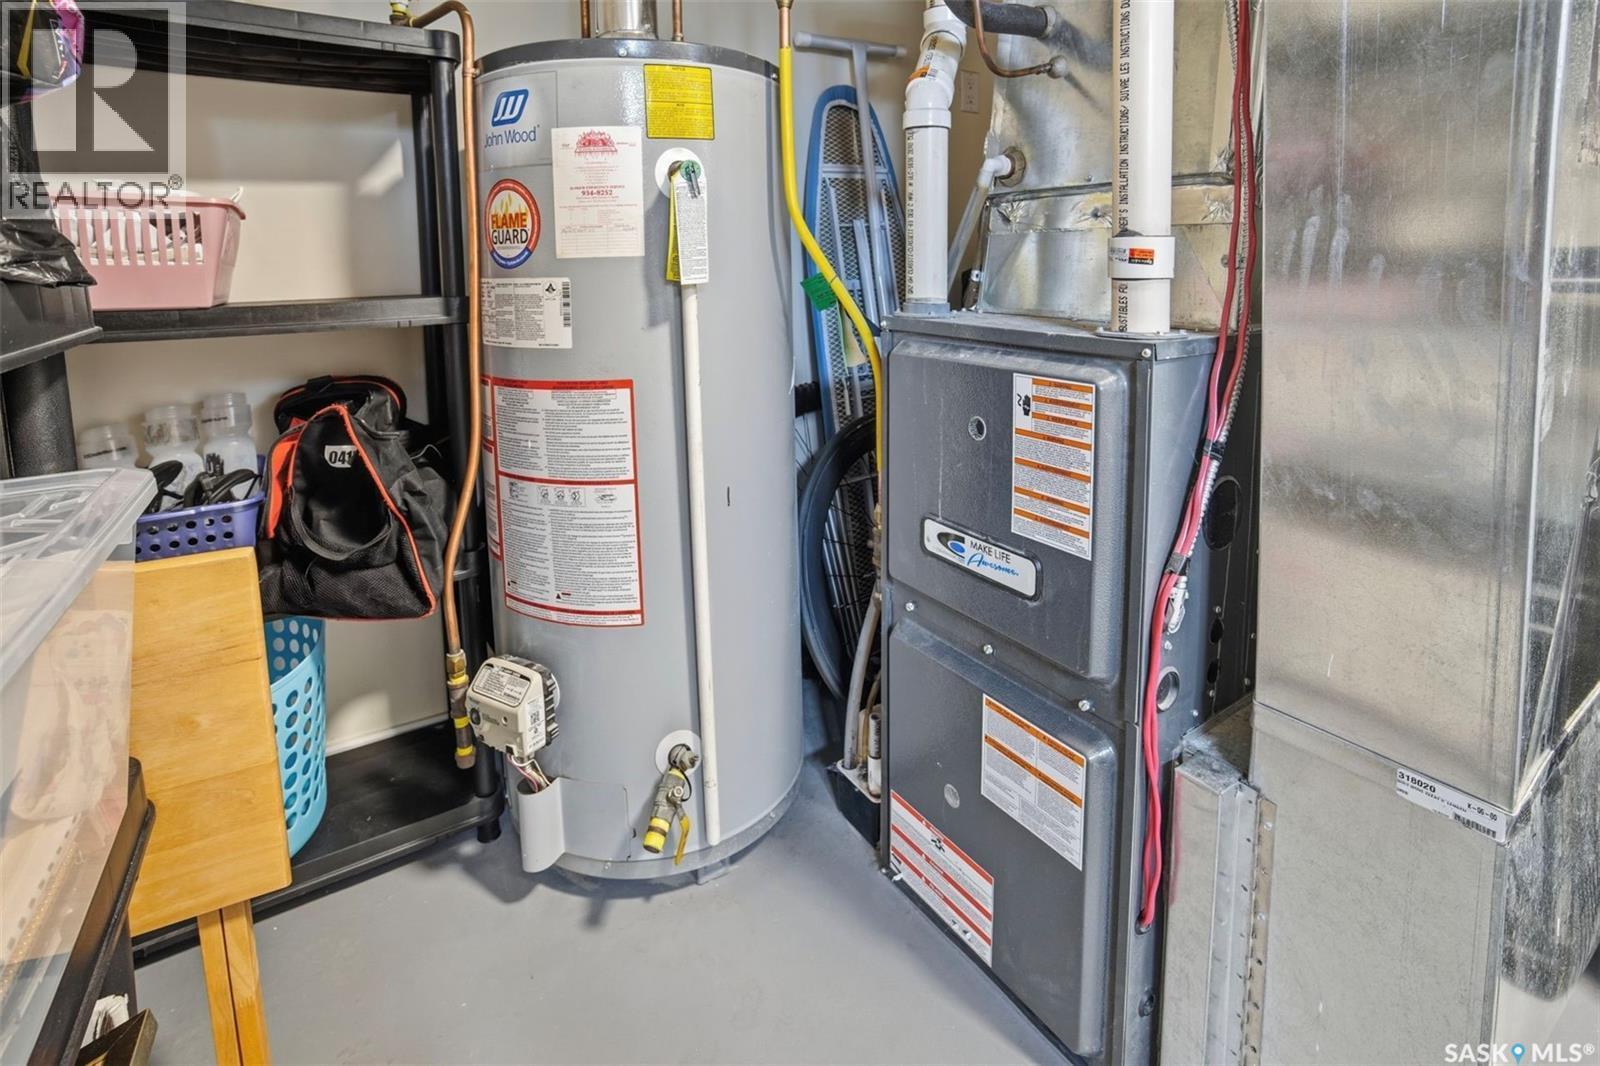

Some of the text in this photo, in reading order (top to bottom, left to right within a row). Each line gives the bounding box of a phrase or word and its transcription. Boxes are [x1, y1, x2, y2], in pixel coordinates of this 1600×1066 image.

[1120, 11, 1130, 58] INSTRUCTIONS
[1120, 62, 1130, 75] LES
[1120, 78, 1130, 101] SUIVRE
[484, 126, 537, 148] John Wood
[1119, 158, 1129, 205] INSTALLATION
[491, 212, 527, 229] FLAME
[491, 229, 528, 245] GUARD
[970, 541, 1011, 564] MAKE LIFE
[1397, 771, 1436, 794] 318020
